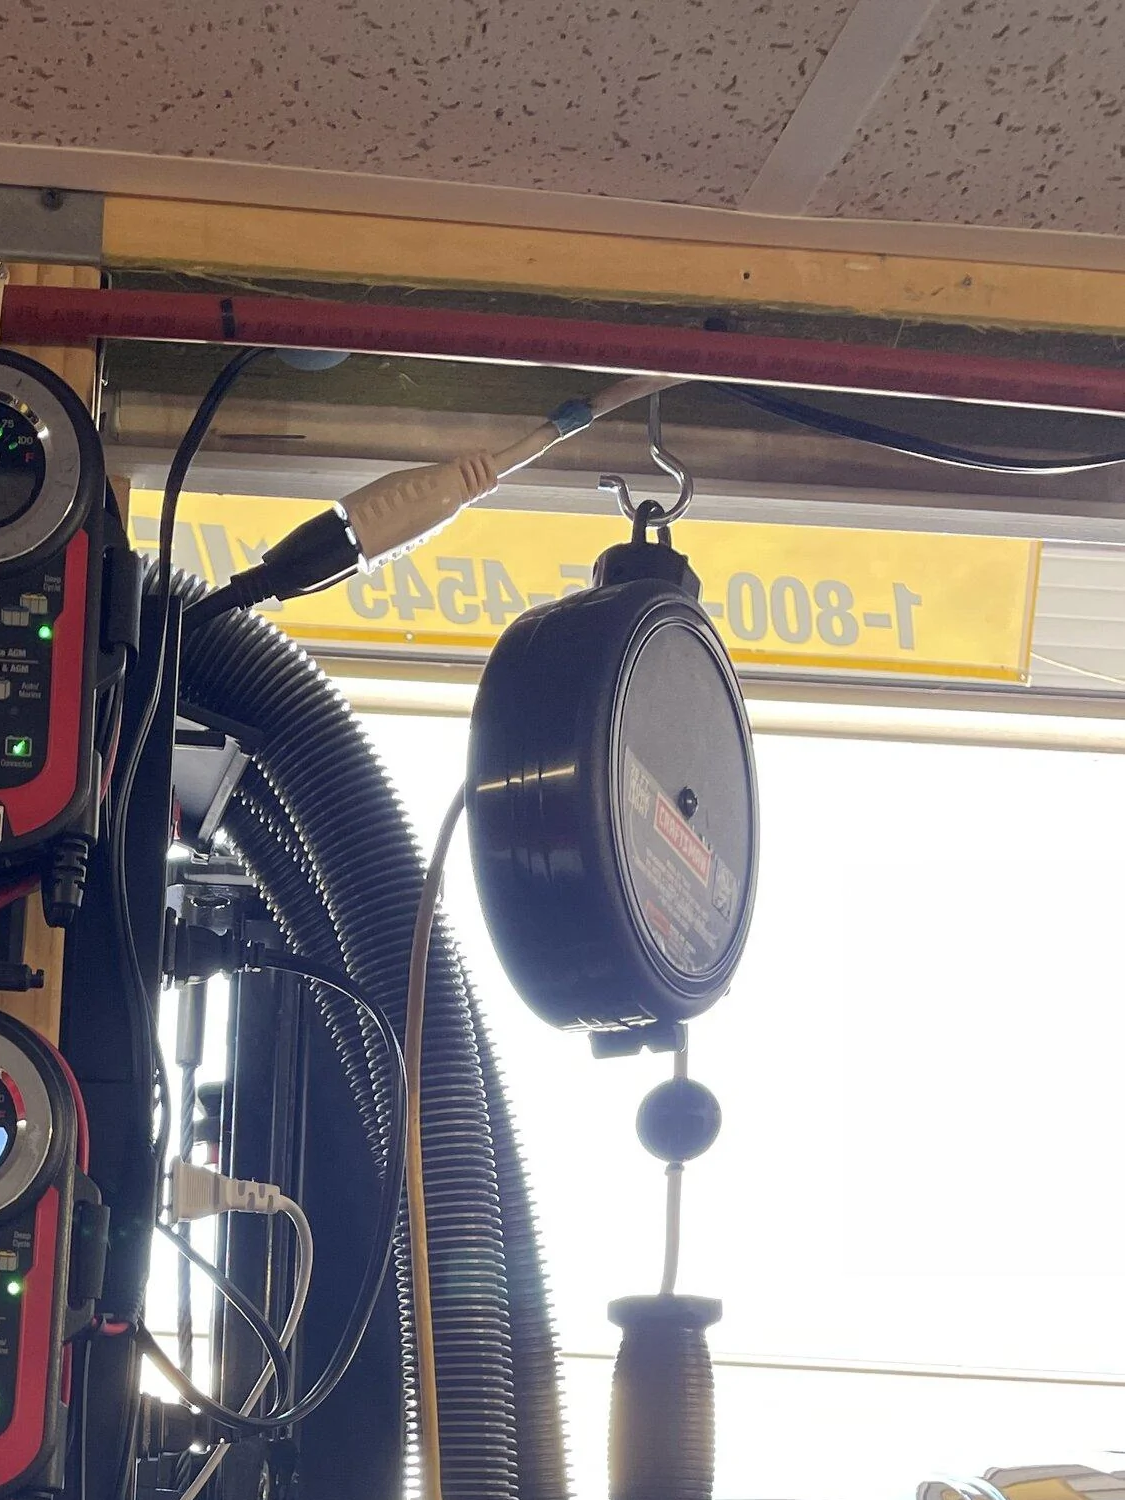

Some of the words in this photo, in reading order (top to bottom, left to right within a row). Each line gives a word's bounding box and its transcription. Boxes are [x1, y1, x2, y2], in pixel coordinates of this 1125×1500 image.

[1, 419, 15, 428] 75
[17, 435, 33, 445] 100
[45, 575, 61, 584] Deep
[43, 583, 61, 592] Cycle
[7, 648, 26, 658] AGM
[10, 663, 29, 673] AGM
[14, 1231, 31, 1240] Deep
[13, 1239, 31, 1248] Cycle
